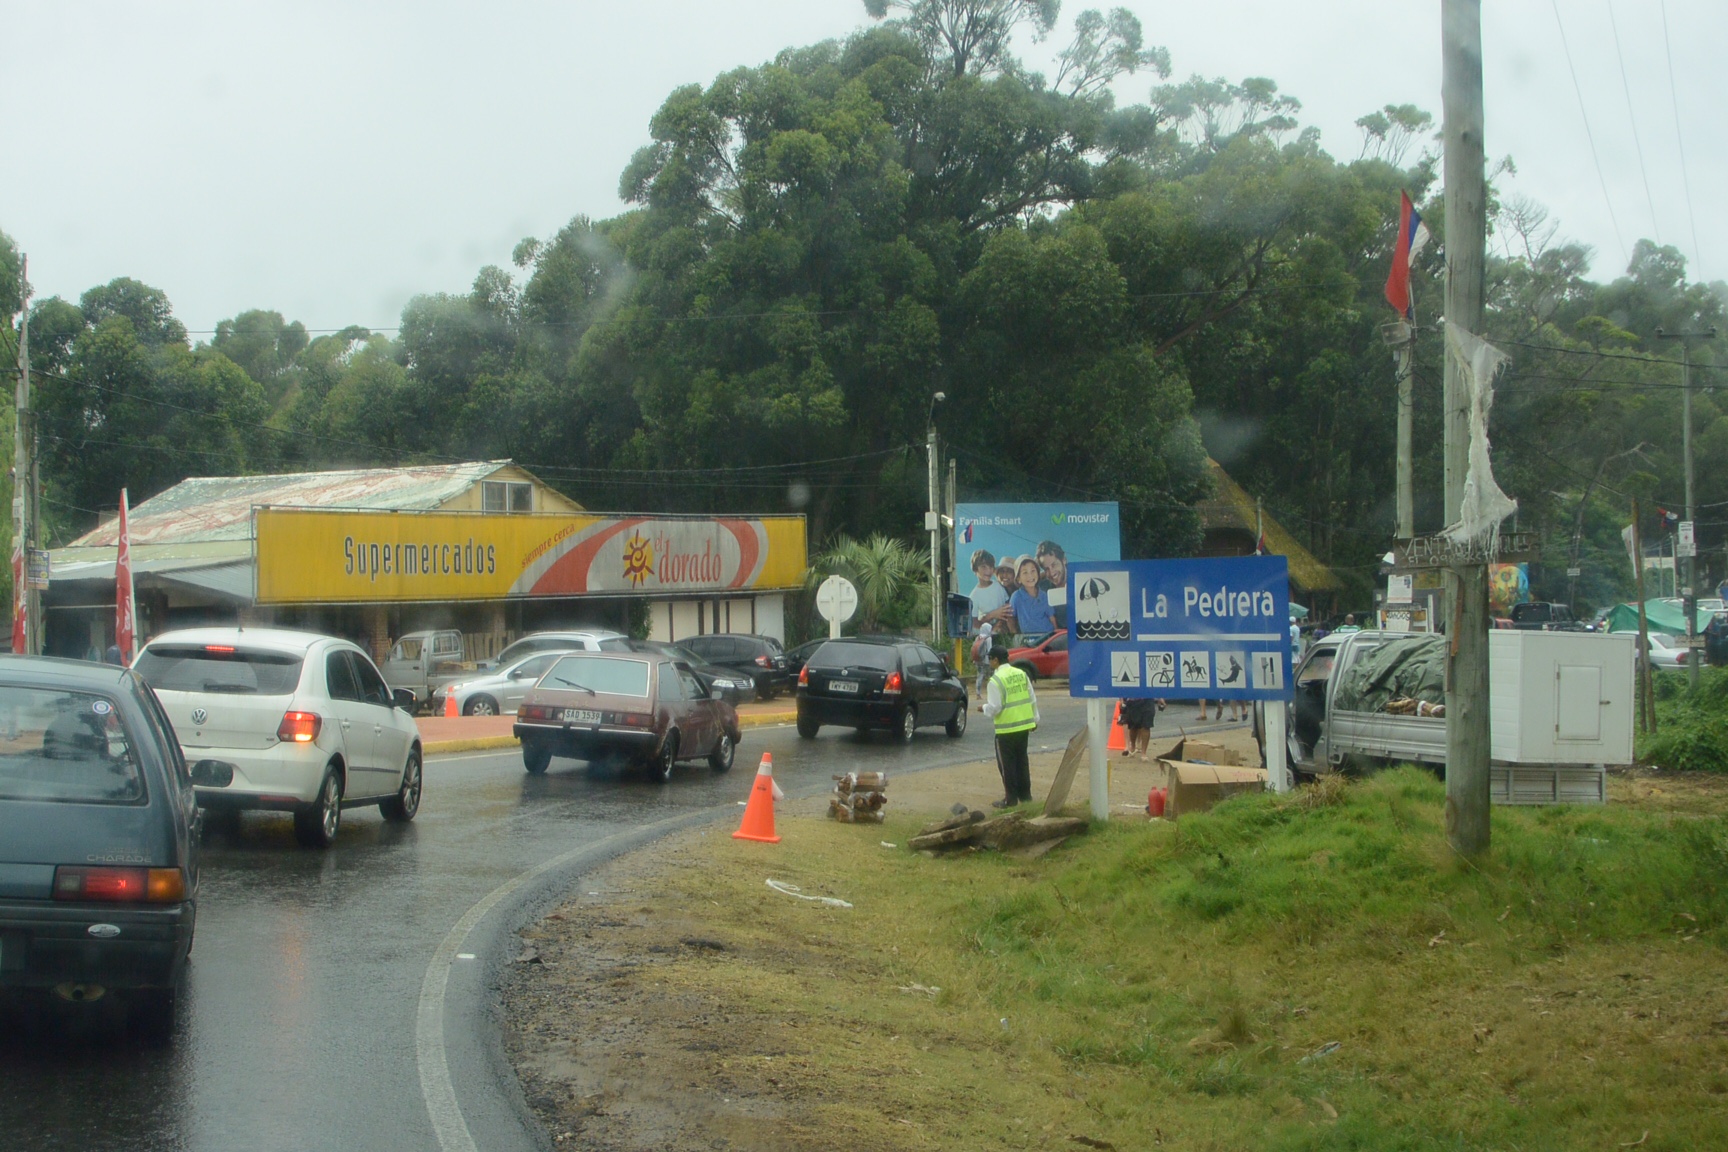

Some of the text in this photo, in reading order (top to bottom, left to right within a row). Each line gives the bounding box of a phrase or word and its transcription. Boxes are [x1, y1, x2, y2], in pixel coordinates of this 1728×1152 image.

[958, 516, 1022, 526] Familia Smart
[1067, 512, 1110, 524] movistar
[520, 523, 576, 569] siempre cerca
[654, 530, 664, 553] el
[344, 536, 496, 582] Supermercados
[658, 537, 722, 585] dorado
[1141, 585, 1275, 618] La Pedrera
[566, 710, 600, 721] SAD 1539
[86, 854, 152, 863] CHARADE
